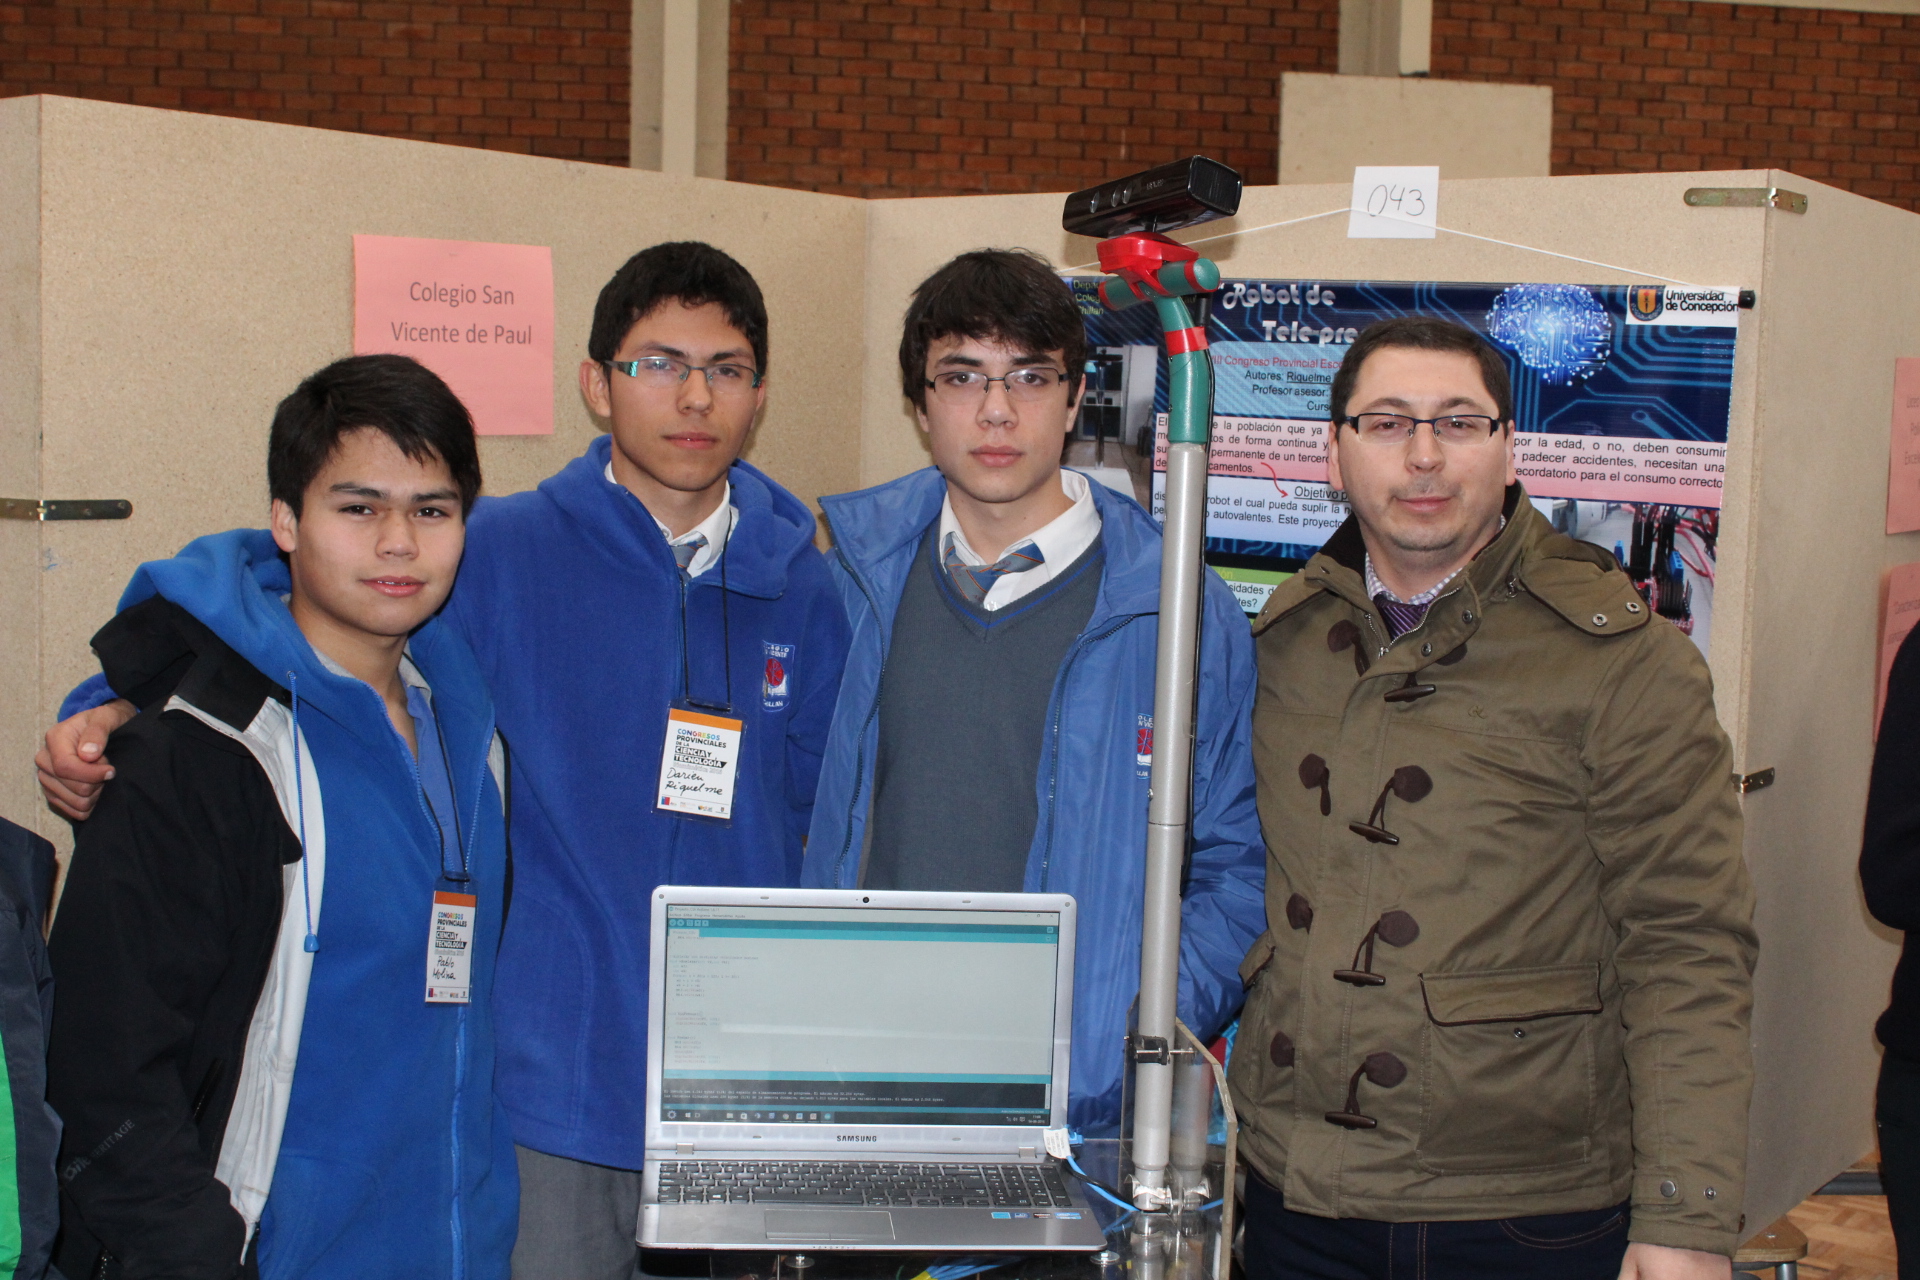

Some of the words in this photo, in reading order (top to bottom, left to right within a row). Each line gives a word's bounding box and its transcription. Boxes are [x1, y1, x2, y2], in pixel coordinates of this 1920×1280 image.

[1367, 184, 1426, 217] 043
[410, 282, 476, 307] Colegio
[483, 285, 514, 305] San
[1306, 284, 1336, 306] de
[1666, 290, 1724, 302] Universidad
[1666, 302, 1678, 311] de
[1680, 301, 1739, 314] Concepción
[391, 322, 459, 343] Vicente
[466, 323, 488, 343] de
[495, 325, 532, 344] Paul
[1225, 355, 1270, 368] Congreso
[1273, 357, 1318, 369] Provincial
[1245, 370, 1284, 381] Autores:
[1287, 371, 1331, 383] Riquelme
[1252, 385, 1292, 396] Profesor
[1294, 388, 1329, 397] asesor:
[1307, 400, 1332, 411] Curs
[1224, 420, 1232, 430] la
[1237, 421, 1281, 433] población
[1288, 426, 1306, 435] que
[1311, 427, 1322, 436] ya
[1228, 435, 1240, 444] de
[1245, 436, 1271, 446] forma
[1277, 438, 1317, 449] continua
[1514, 438, 1532, 447] por
[1538, 437, 1548, 447] la
[1555, 438, 1585, 451] edad,
[1593, 442, 1600, 450] o
[1607, 442, 1625, 453] no,
[1633, 442, 1669, 453] deben
[1676, 446, 1726, 458] consumir
[1211, 448, 1266, 460] permanente
[1268, 451, 1280, 461] de
[1284, 453, 1296, 462] un
[1522, 452, 1566, 465] padecer
[1573, 454, 1637, 468] accidentes,
[1644, 458, 1698, 471] necesitan
[1704, 463, 1725, 473] una
[1580, 471, 1606, 483] para
[1610, 471, 1620, 482] el
[1624, 474, 1676, 485] consumo
[1679, 476, 1723, 488] correcto
[1294, 486, 1339, 500] Objetivo
[1207, 496, 1230, 506] robot
[1234, 496, 1242, 506] el
[1245, 497, 1265, 508] cual
[1269, 499, 1298, 513] pueda
[1302, 502, 1328, 515] suplir
[1331, 503, 1340, 514] la
[1213, 510, 1274, 523] autovalentes.
[1278, 514, 1299, 525] Este
[677, 728, 721, 741] CONGRESOS
[676, 735, 727, 749] PROVINCIALES
[675, 746, 706, 757] CIENCIA
[837, 1135, 877, 1143] SAMSUNG
